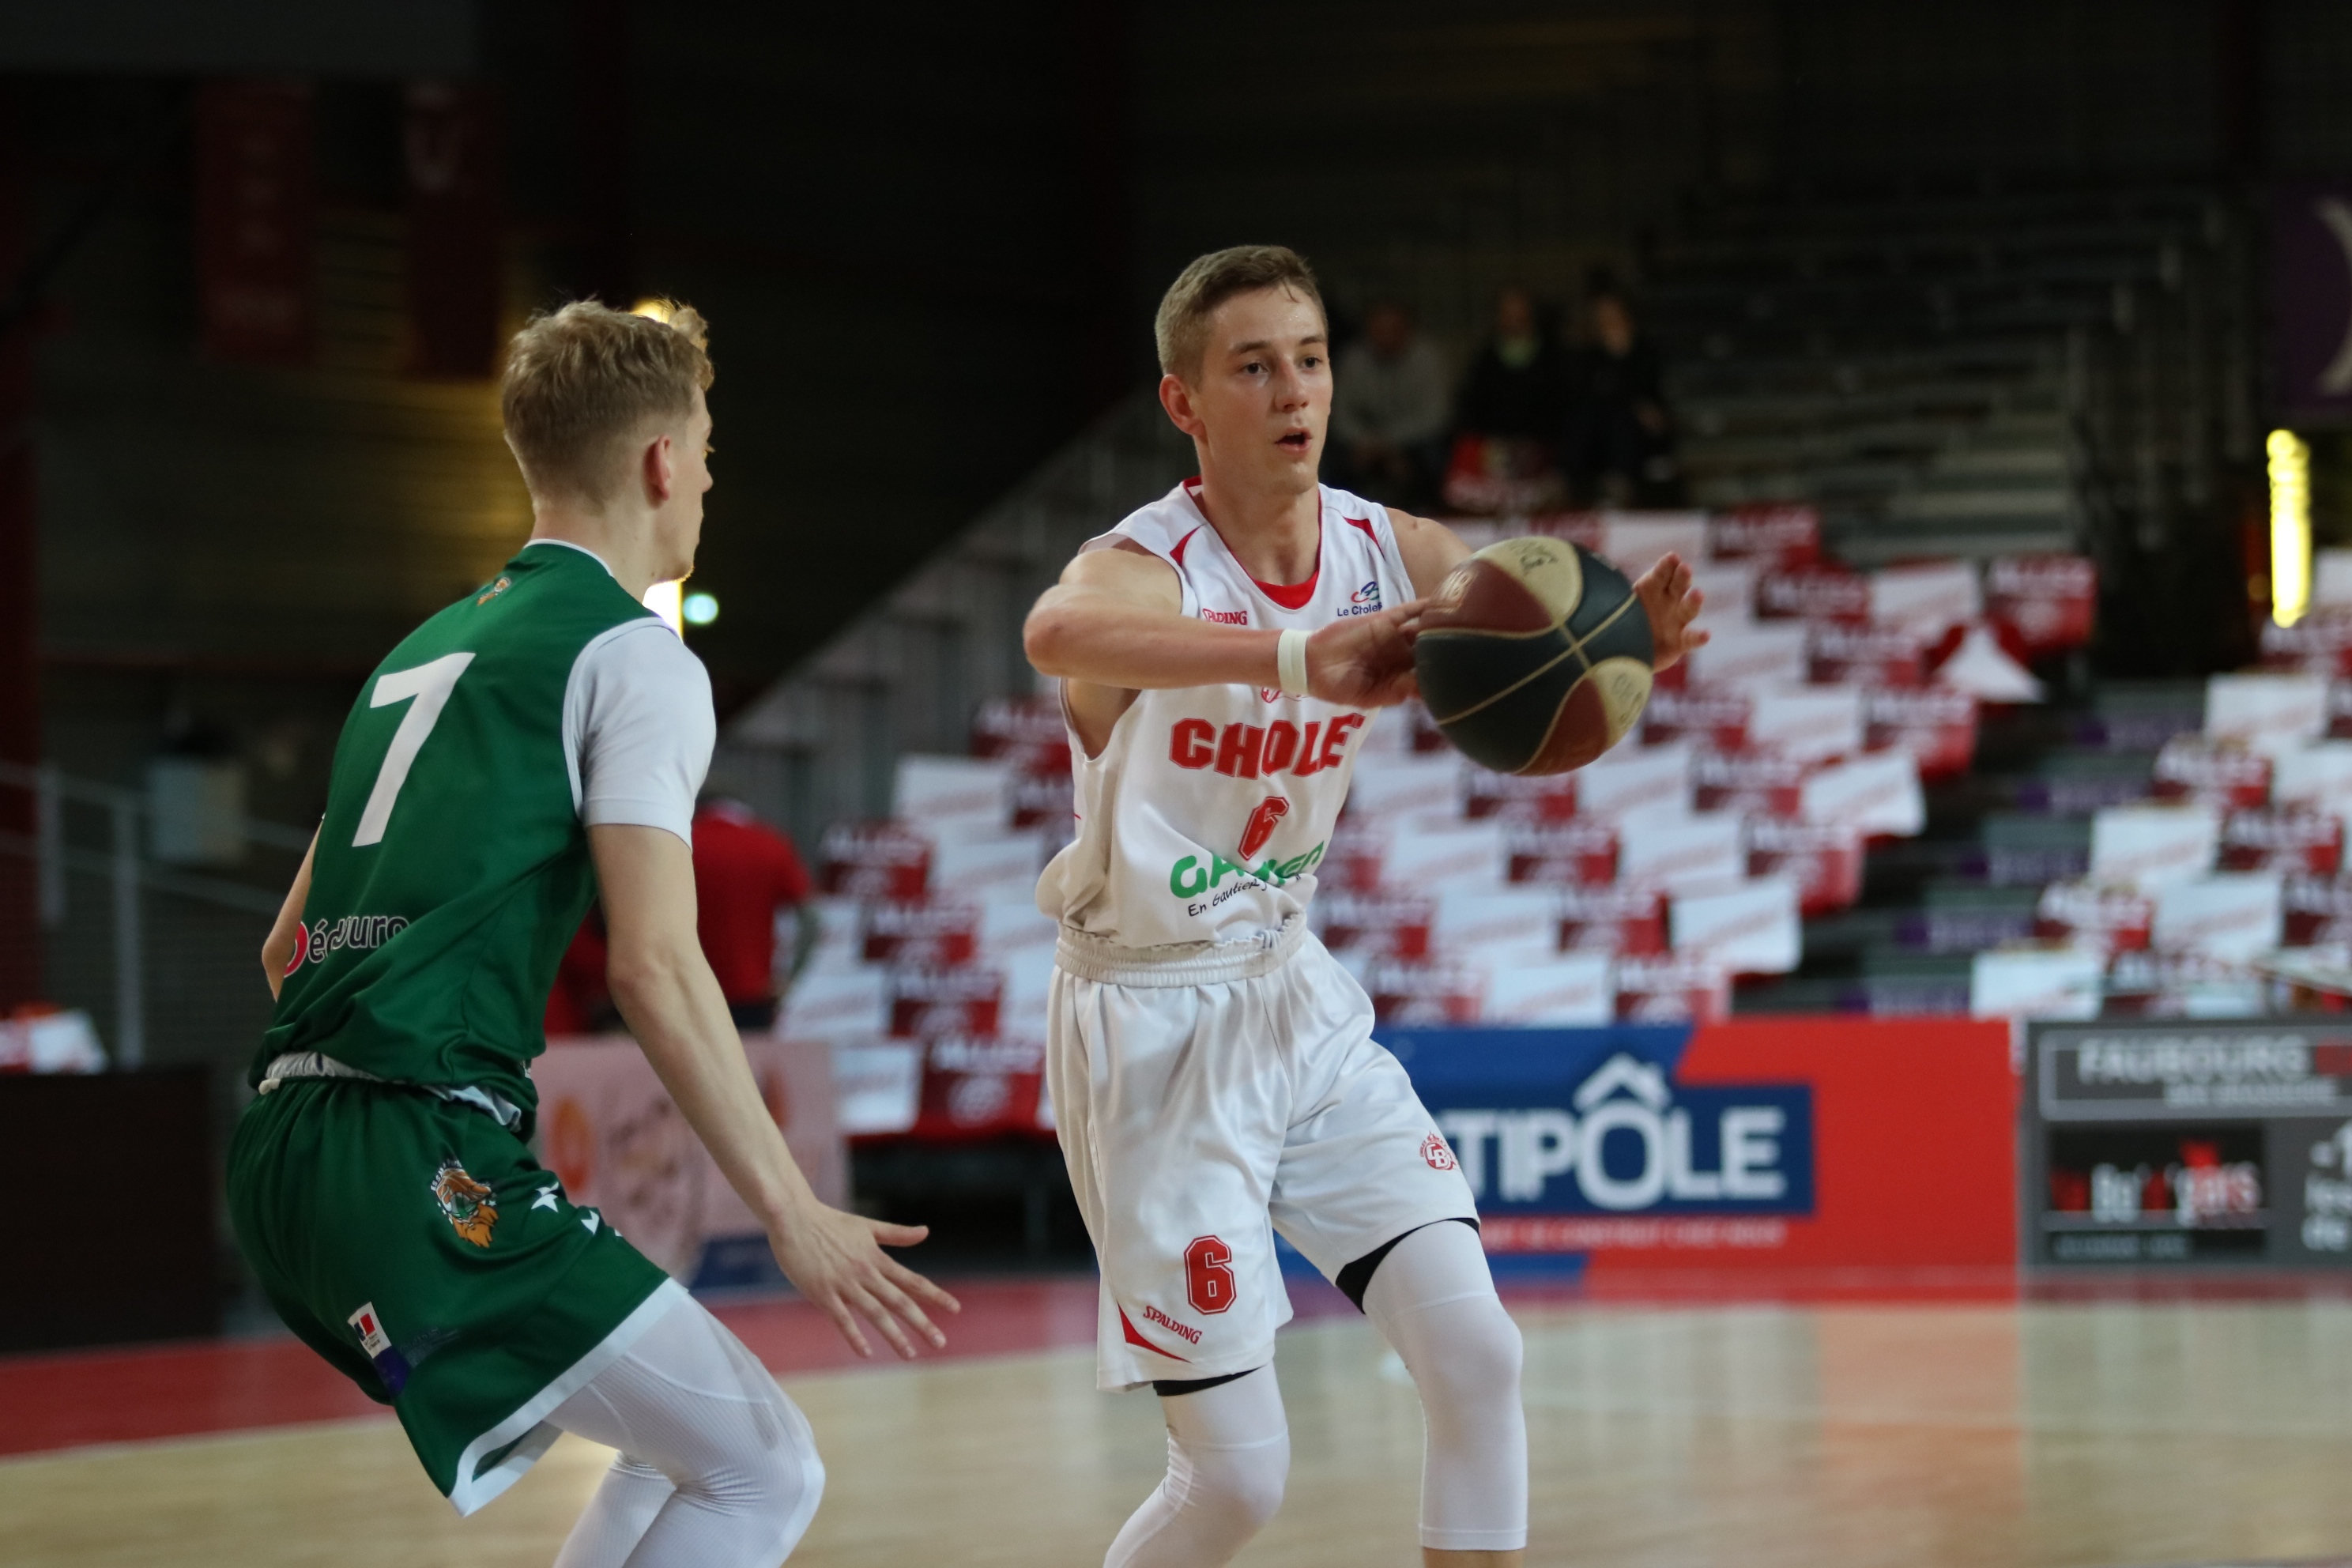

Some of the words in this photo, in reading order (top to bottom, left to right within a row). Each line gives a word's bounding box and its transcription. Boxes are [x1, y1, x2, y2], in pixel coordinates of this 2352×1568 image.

[1336, 608, 1349, 616] Le
[352, 652, 476, 847] 7
[1238, 796, 1290, 861] 6
[1188, 903, 1207, 917] En
[1183, 1234, 1237, 1316] 6
[1143, 1305, 1203, 1345] SPALDING
